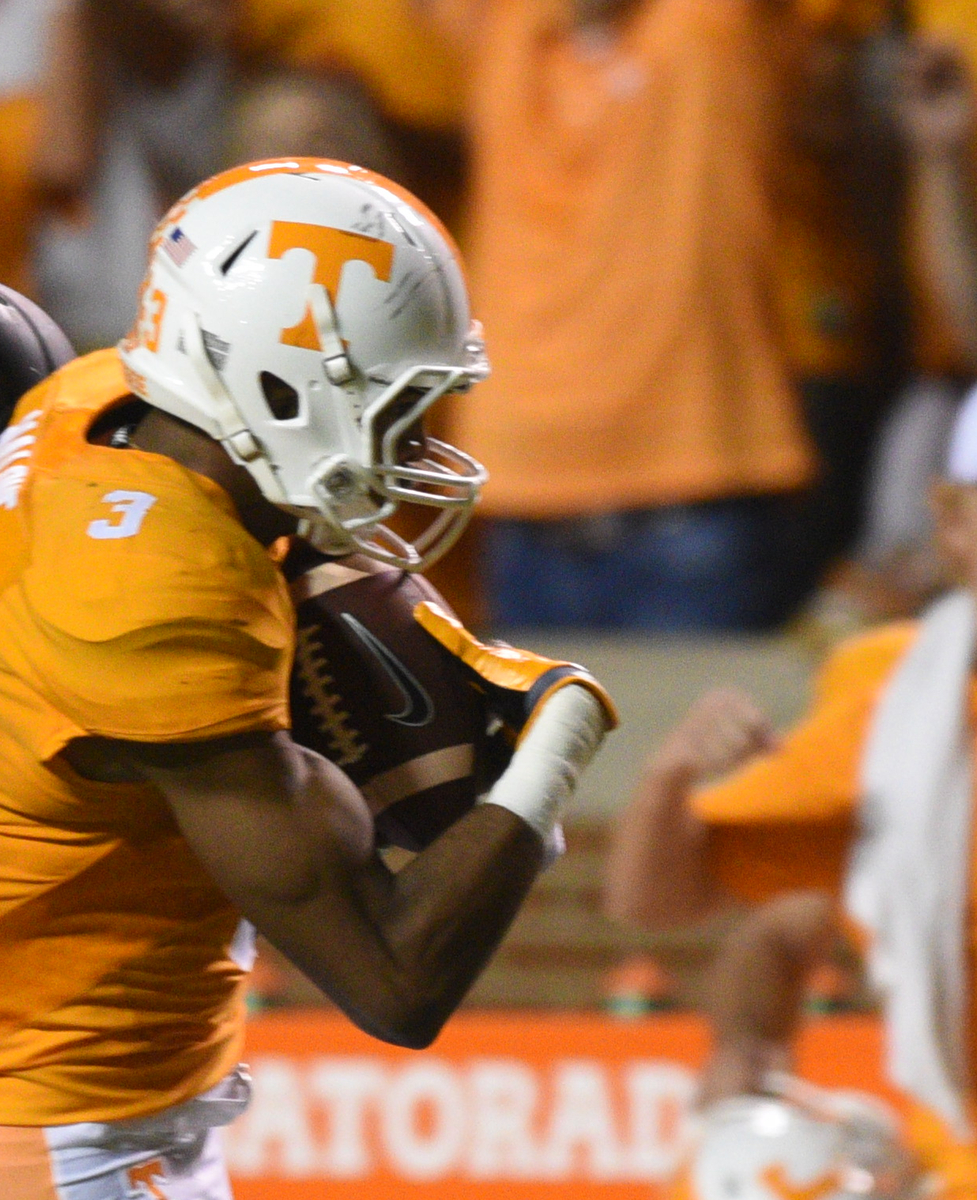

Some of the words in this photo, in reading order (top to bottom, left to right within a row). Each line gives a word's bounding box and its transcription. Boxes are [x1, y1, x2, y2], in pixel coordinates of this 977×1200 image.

[268, 220, 396, 353] T
[87, 489, 158, 540] 3
[228, 1056, 700, 1182] ATORAD
